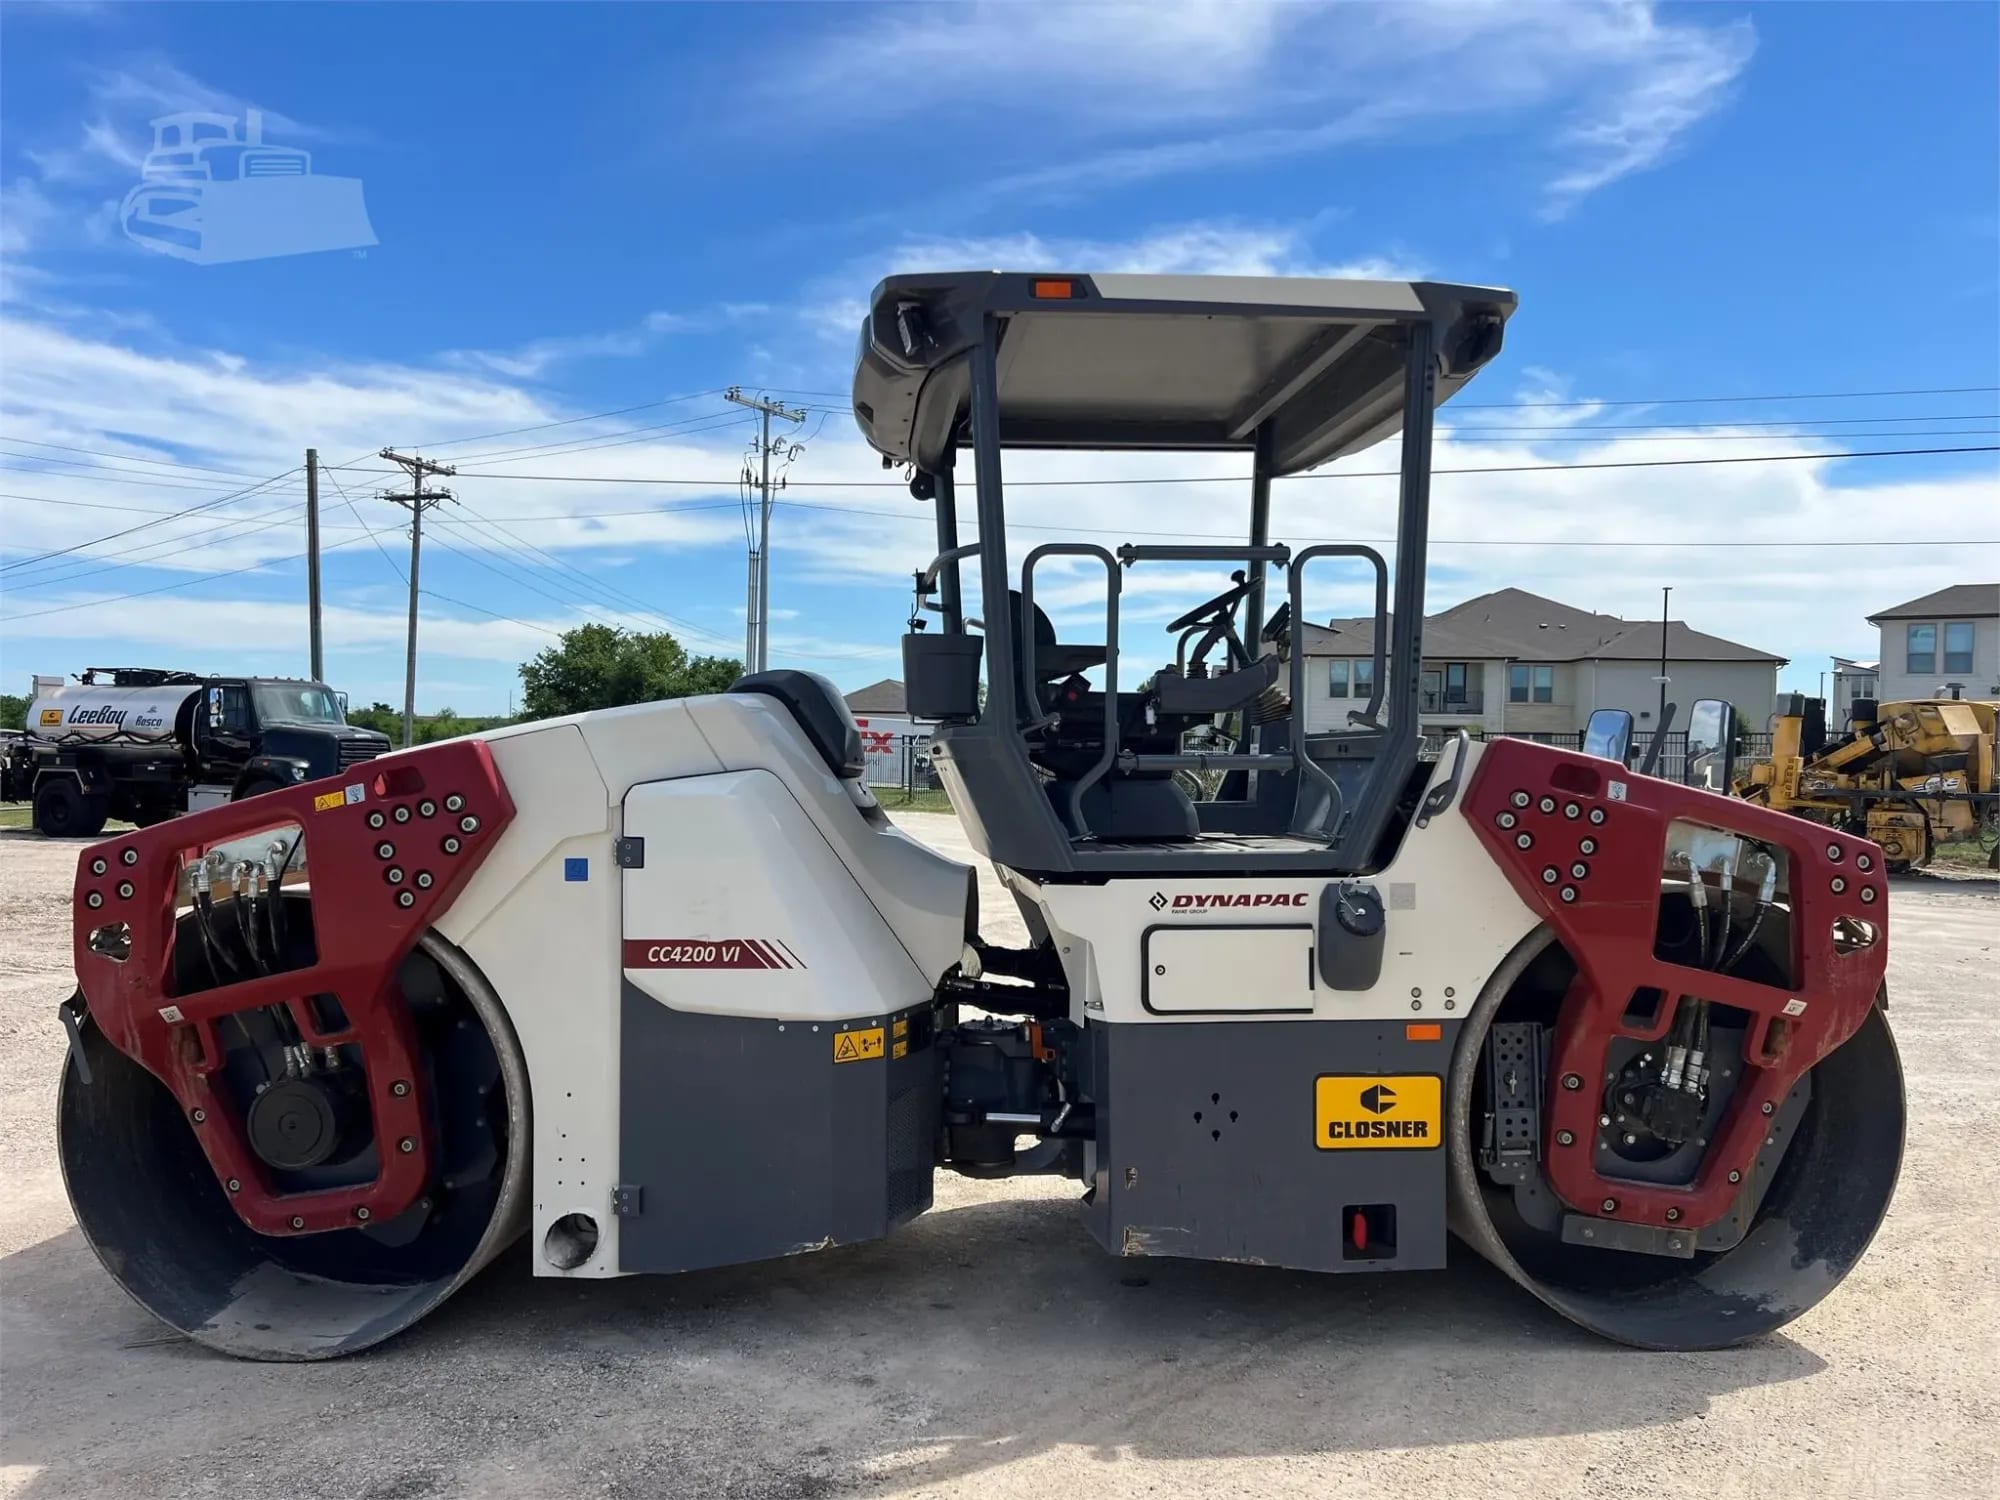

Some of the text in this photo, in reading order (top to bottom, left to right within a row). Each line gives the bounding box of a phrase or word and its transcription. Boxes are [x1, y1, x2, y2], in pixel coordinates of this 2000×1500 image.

[68, 705, 128, 731] LeeBoy
[135, 715, 163, 726] Rosco
[1172, 893, 1309, 907] DYNAPAC
[648, 946, 740, 962] CC4200 VI
[1328, 1121, 1428, 1138] CLOSNER
